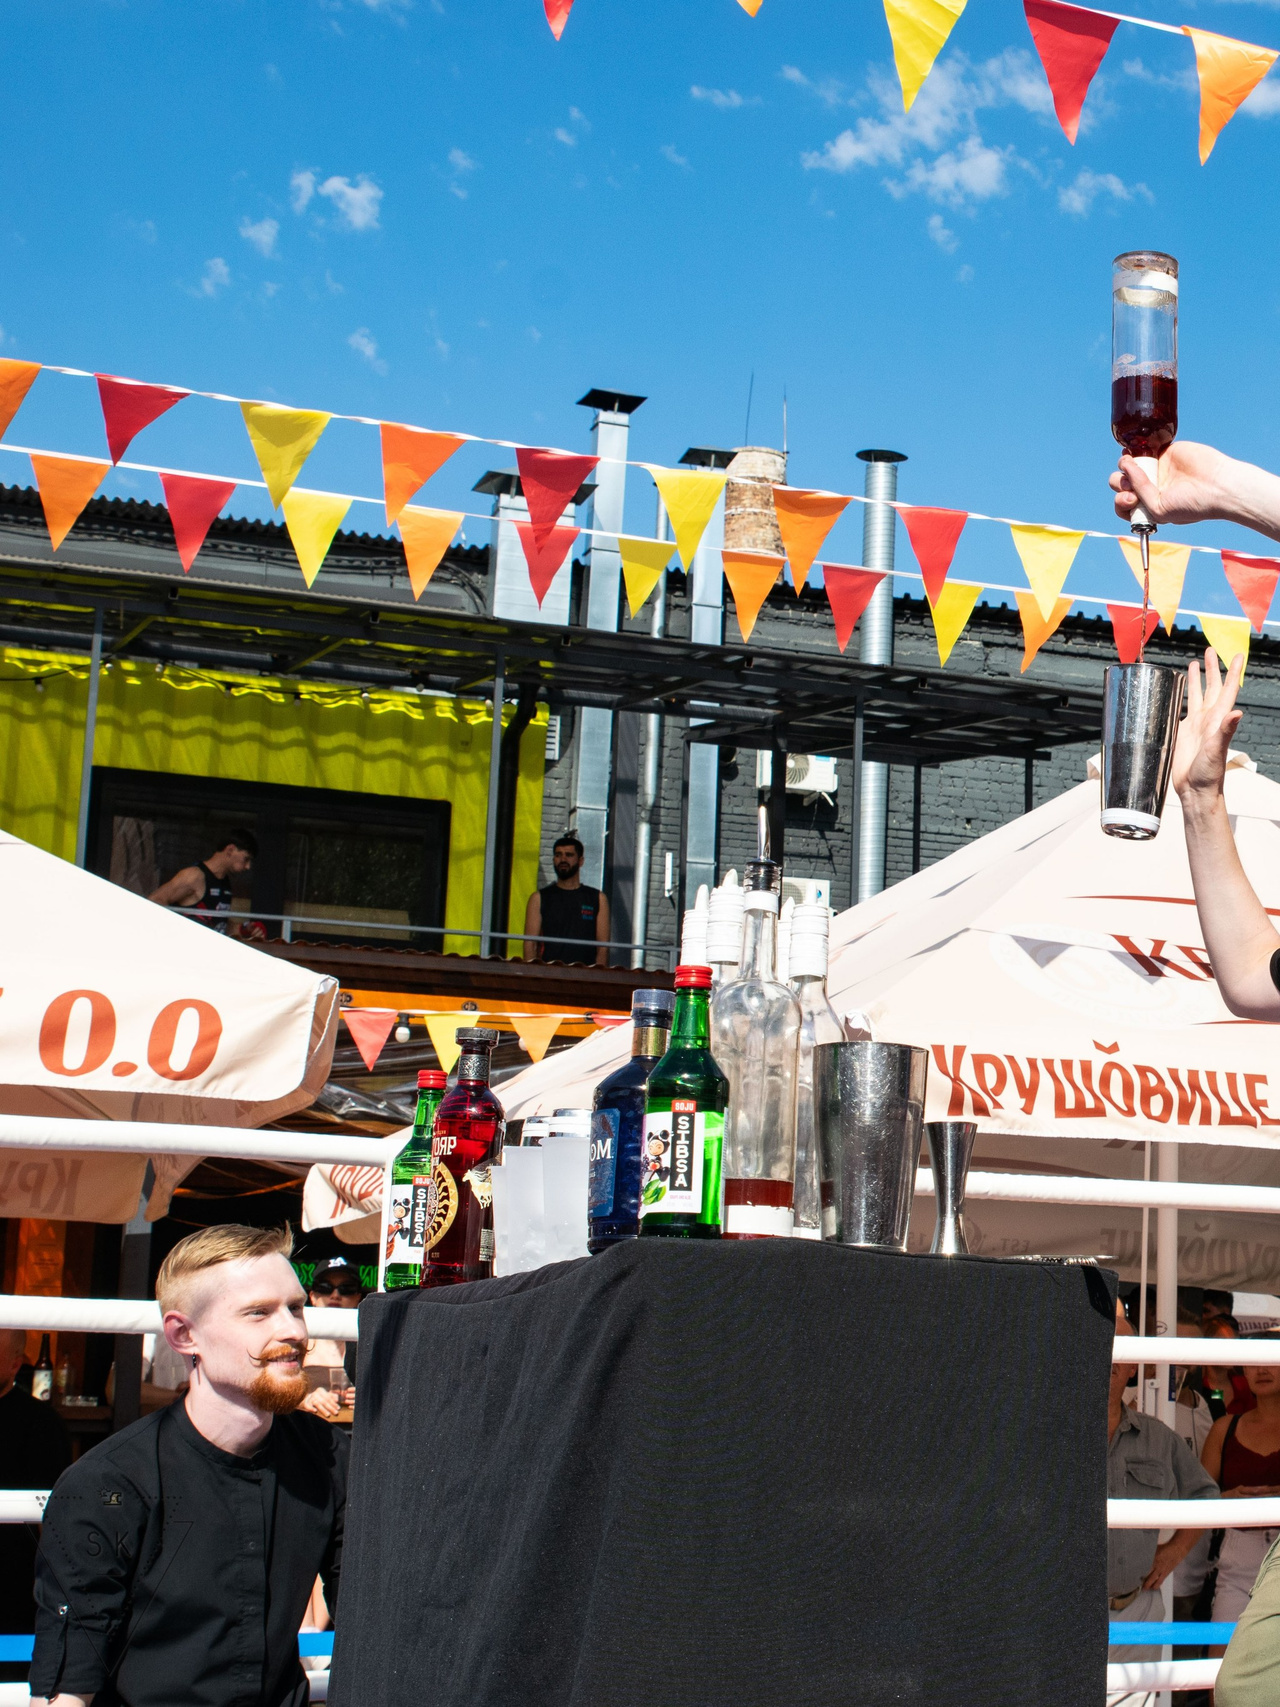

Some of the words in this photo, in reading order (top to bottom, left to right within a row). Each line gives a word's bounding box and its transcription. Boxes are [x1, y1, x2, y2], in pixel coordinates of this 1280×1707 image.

[38, 989, 223, 1081] 0.0
[675, 1102, 694, 1111] SOJU
[674, 1115, 690, 1188] SIBSA
[413, 1188, 426, 1245] SIBSA
